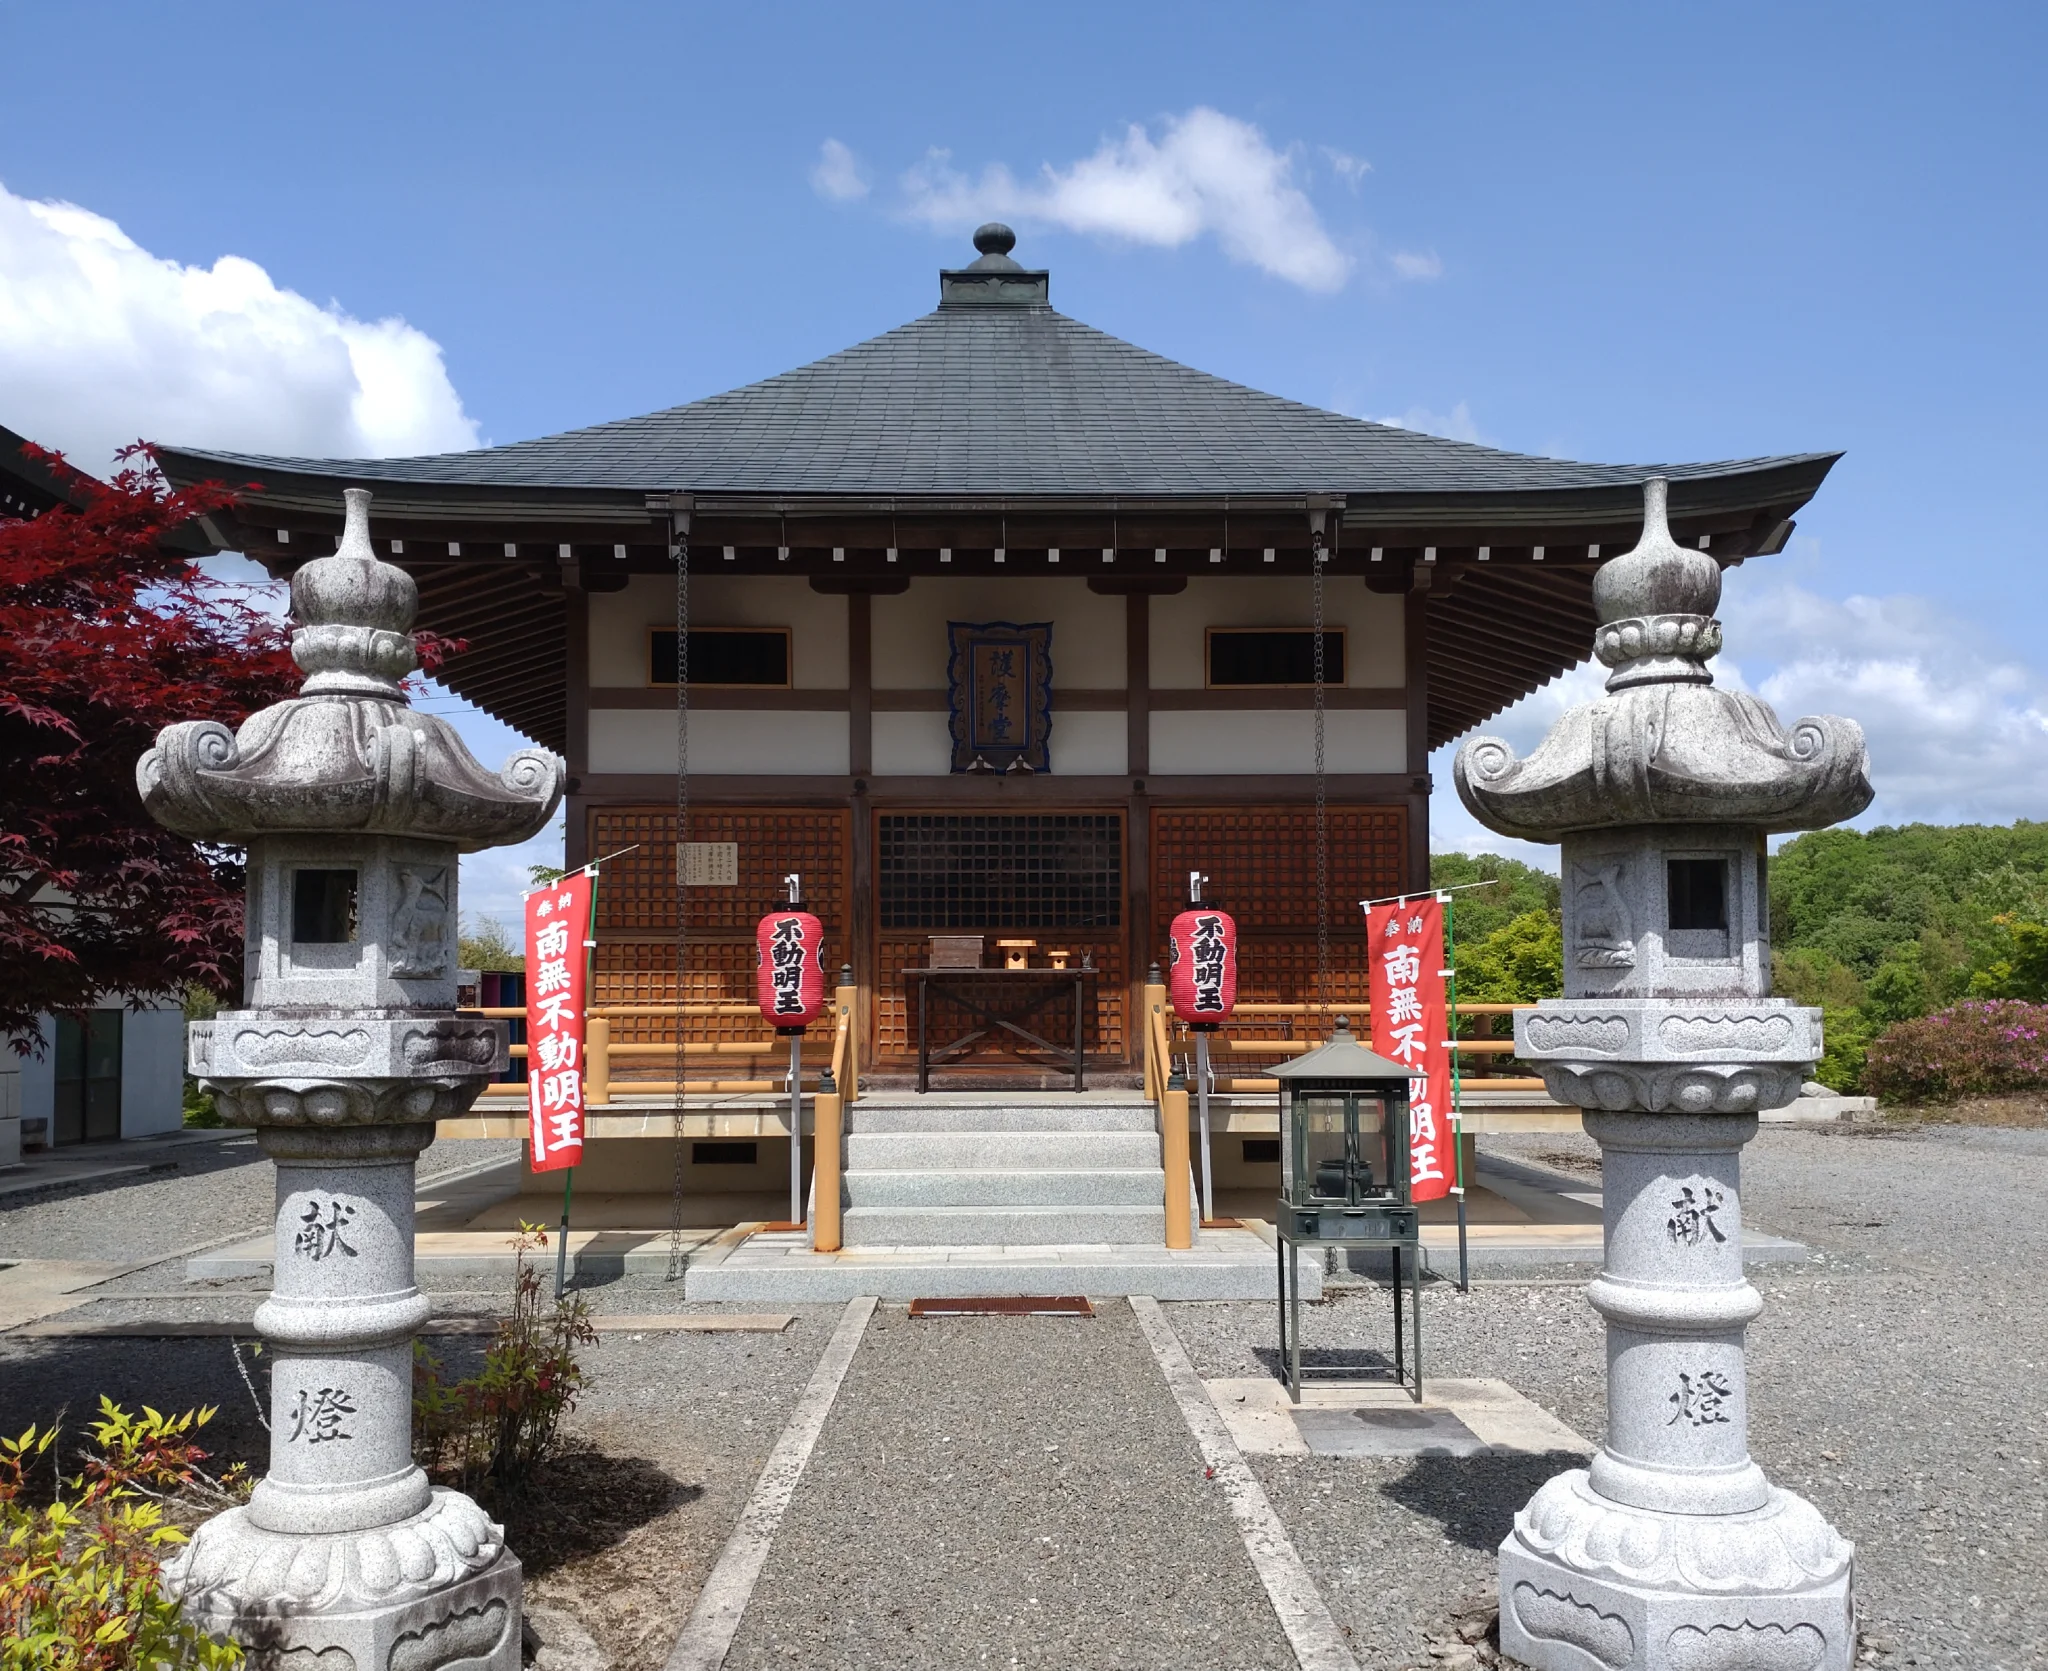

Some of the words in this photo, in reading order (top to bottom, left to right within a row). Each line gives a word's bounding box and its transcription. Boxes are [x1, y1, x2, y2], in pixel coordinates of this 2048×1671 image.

[536, 892, 572, 918] 奉納
[1384, 916, 1423, 938] 奉納
[770, 918, 807, 1015] 不動明王
[1190, 915, 1228, 1012] 不動明王
[535, 920, 583, 1152] 南無不動明王
